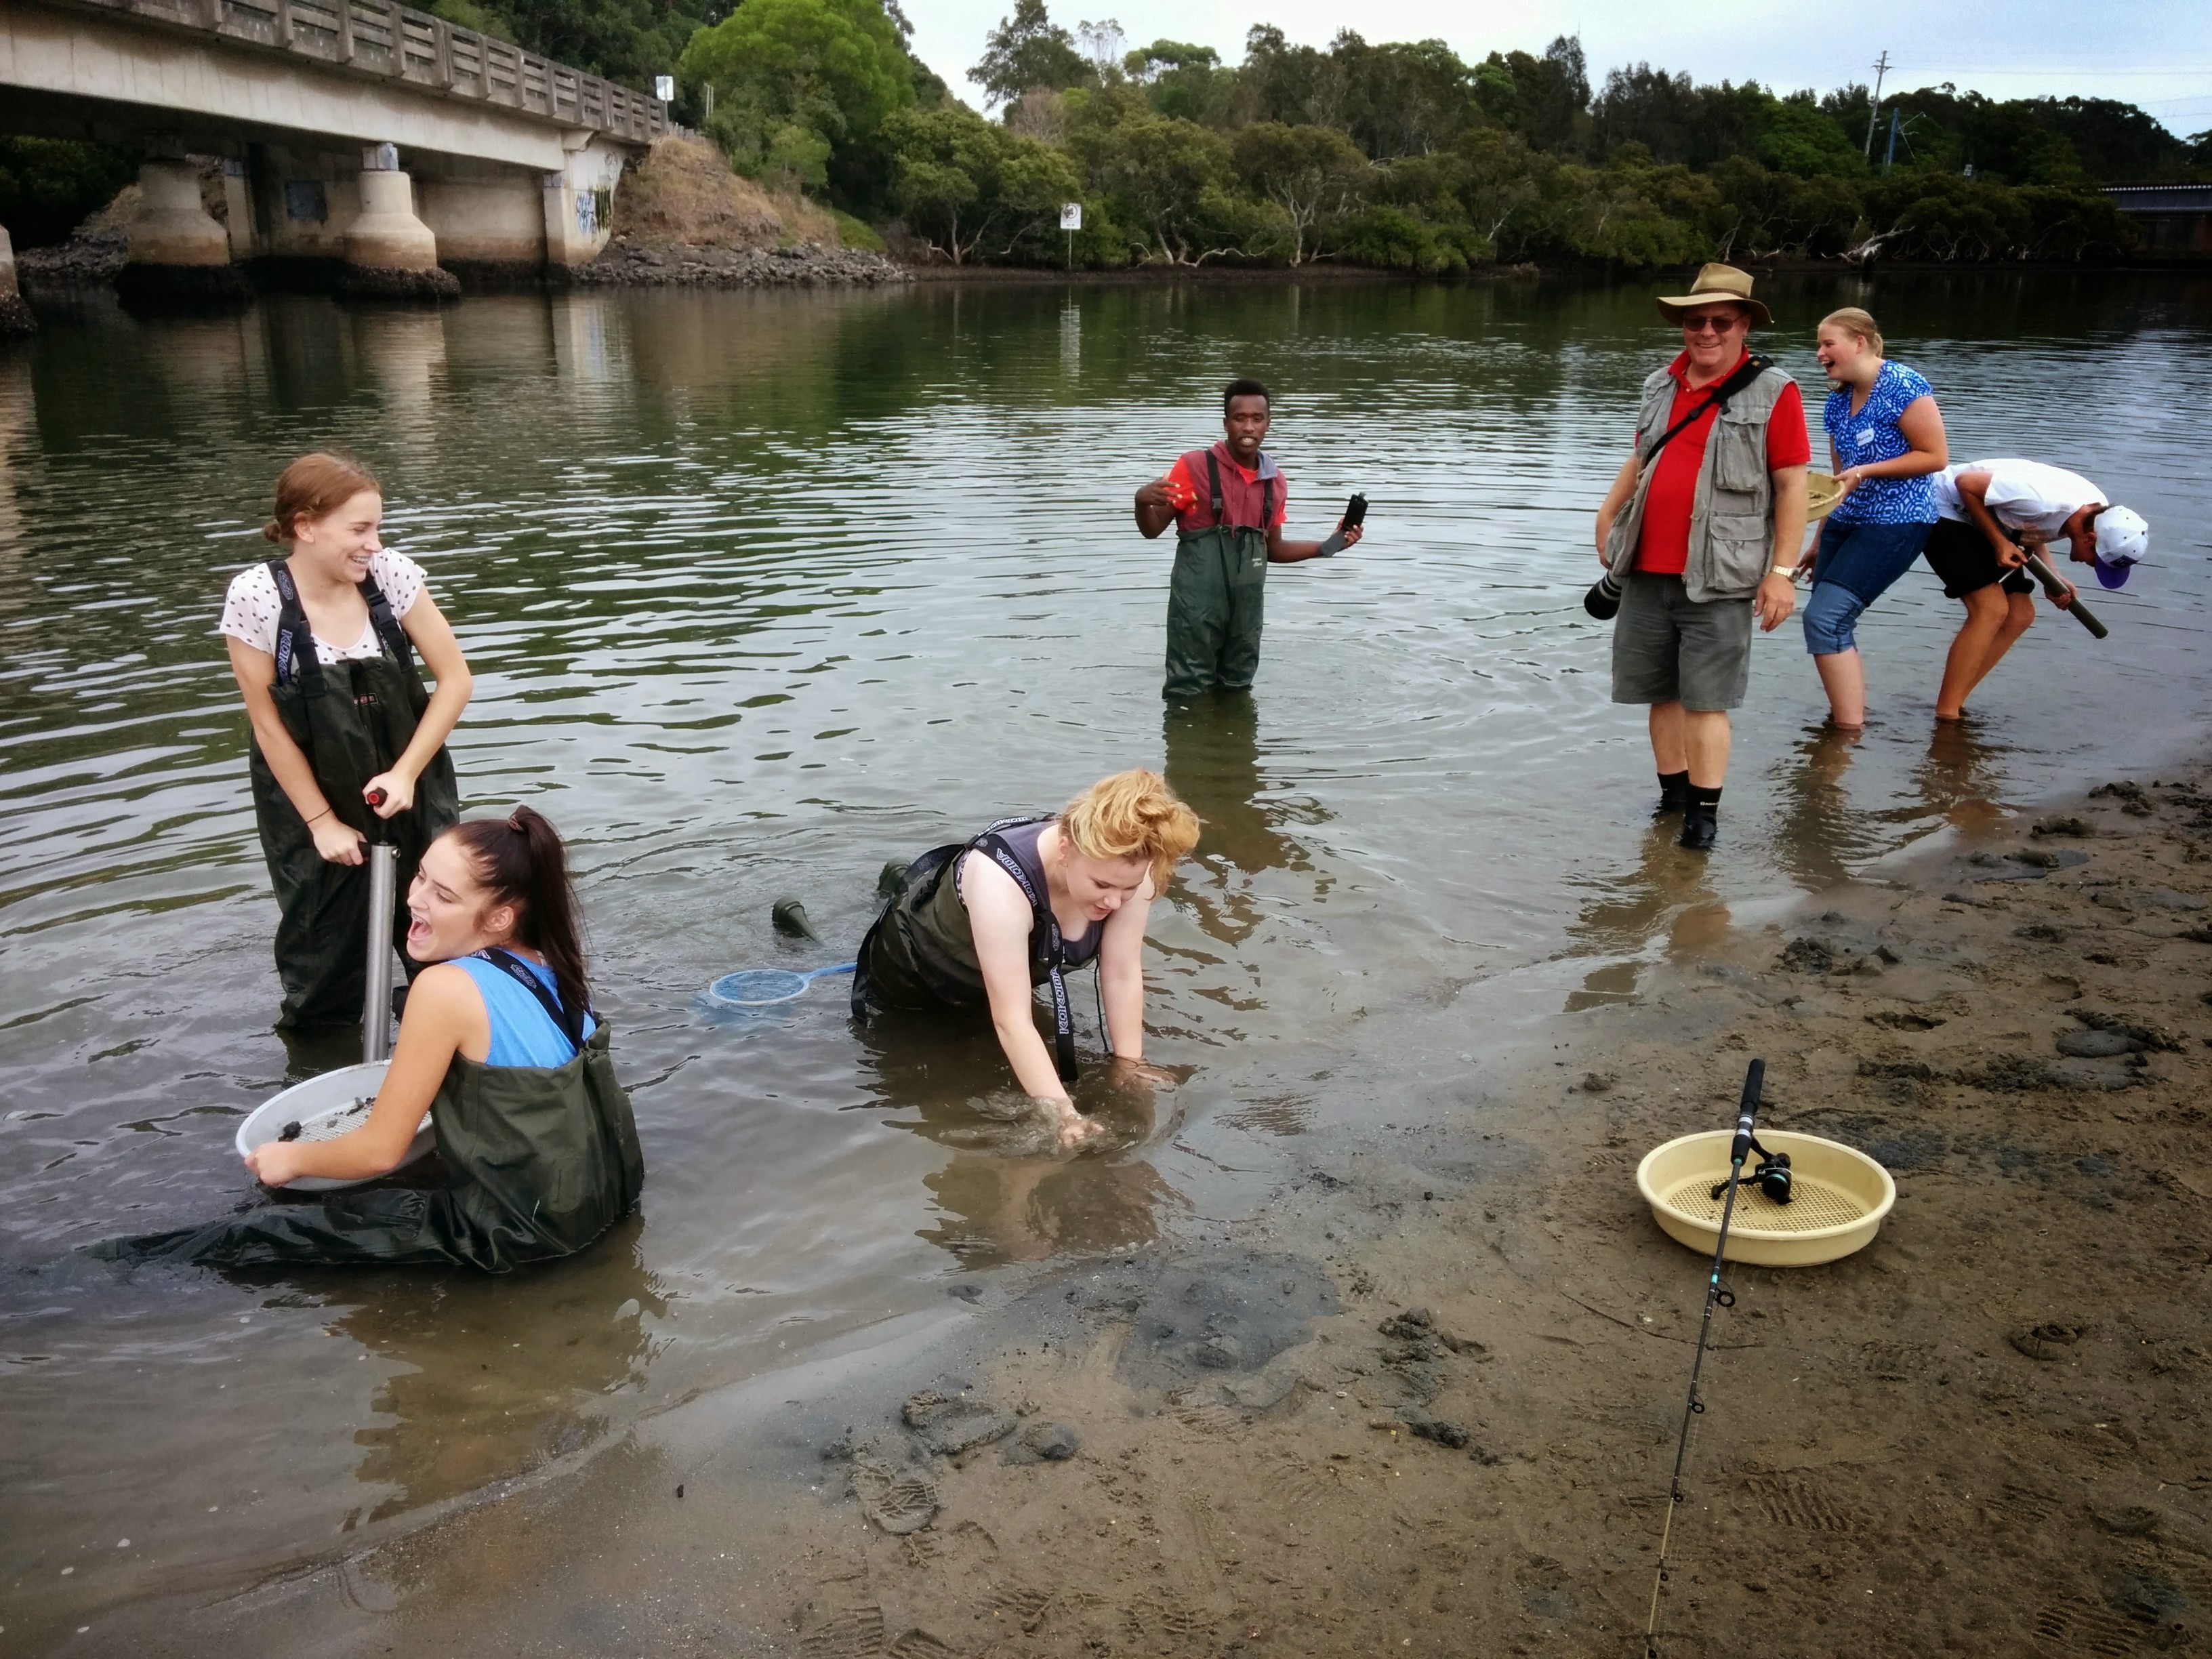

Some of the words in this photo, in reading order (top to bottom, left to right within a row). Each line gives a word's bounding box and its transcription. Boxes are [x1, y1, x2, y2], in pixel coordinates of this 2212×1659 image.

[278, 629, 292, 681] KOKO
[997, 848, 1038, 907] KOKODA
[1050, 964, 1069, 1034] KOKODA
